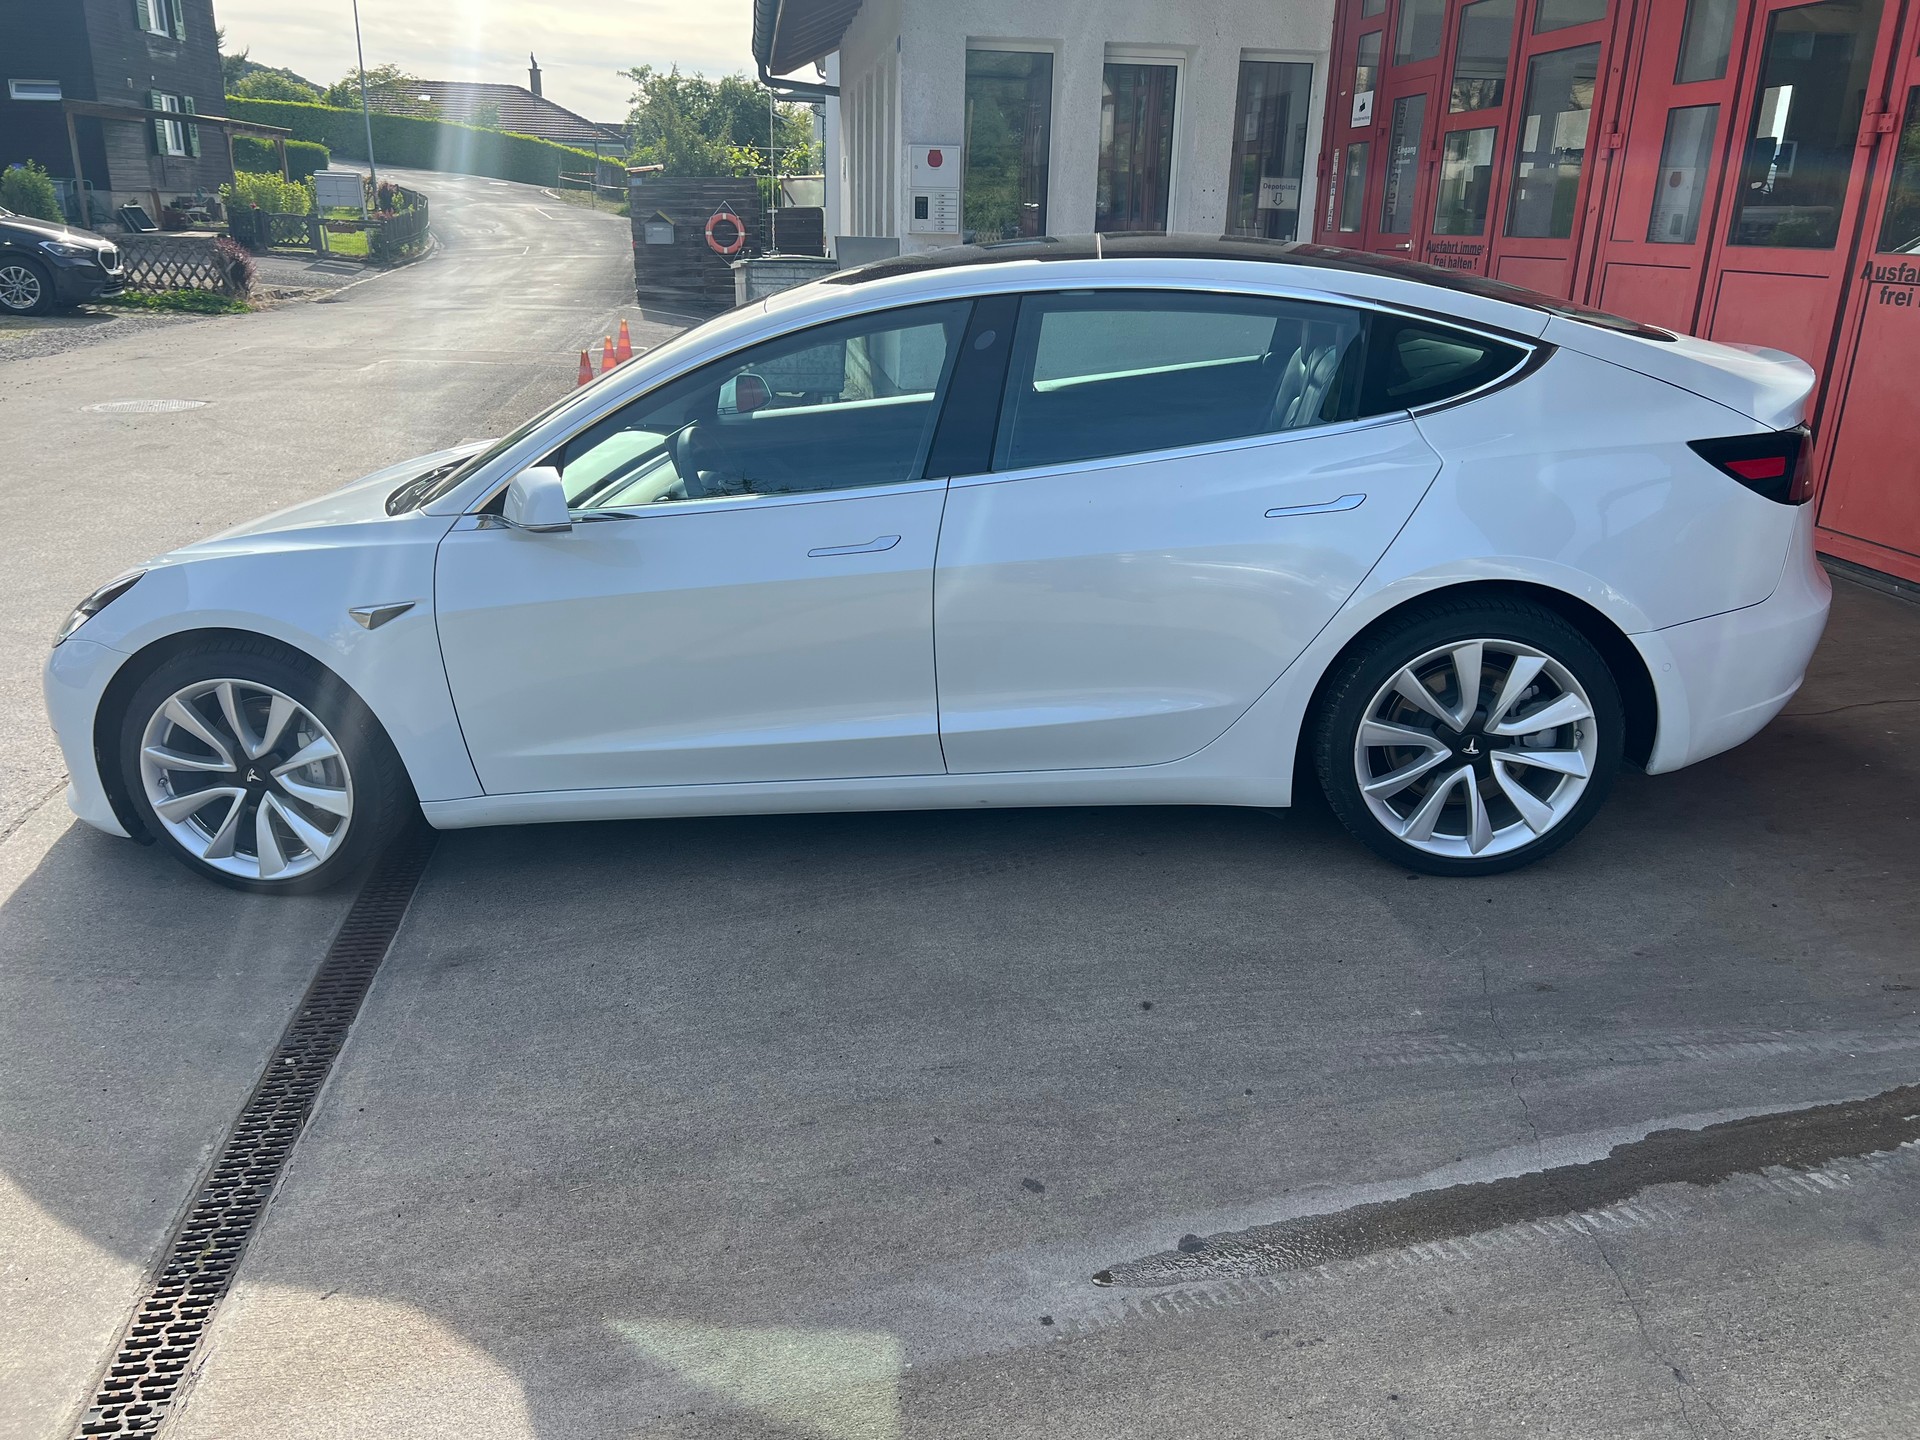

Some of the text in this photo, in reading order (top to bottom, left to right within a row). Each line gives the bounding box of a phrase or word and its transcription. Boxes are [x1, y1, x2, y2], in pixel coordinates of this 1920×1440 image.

[1263, 183, 1296, 192] Depotplatz
[1426, 240, 1458, 253] Ausfahrt
[1433, 255, 1446, 268] frei
[1448, 256, 1472, 269] halten
[1879, 286, 1915, 307] frei
